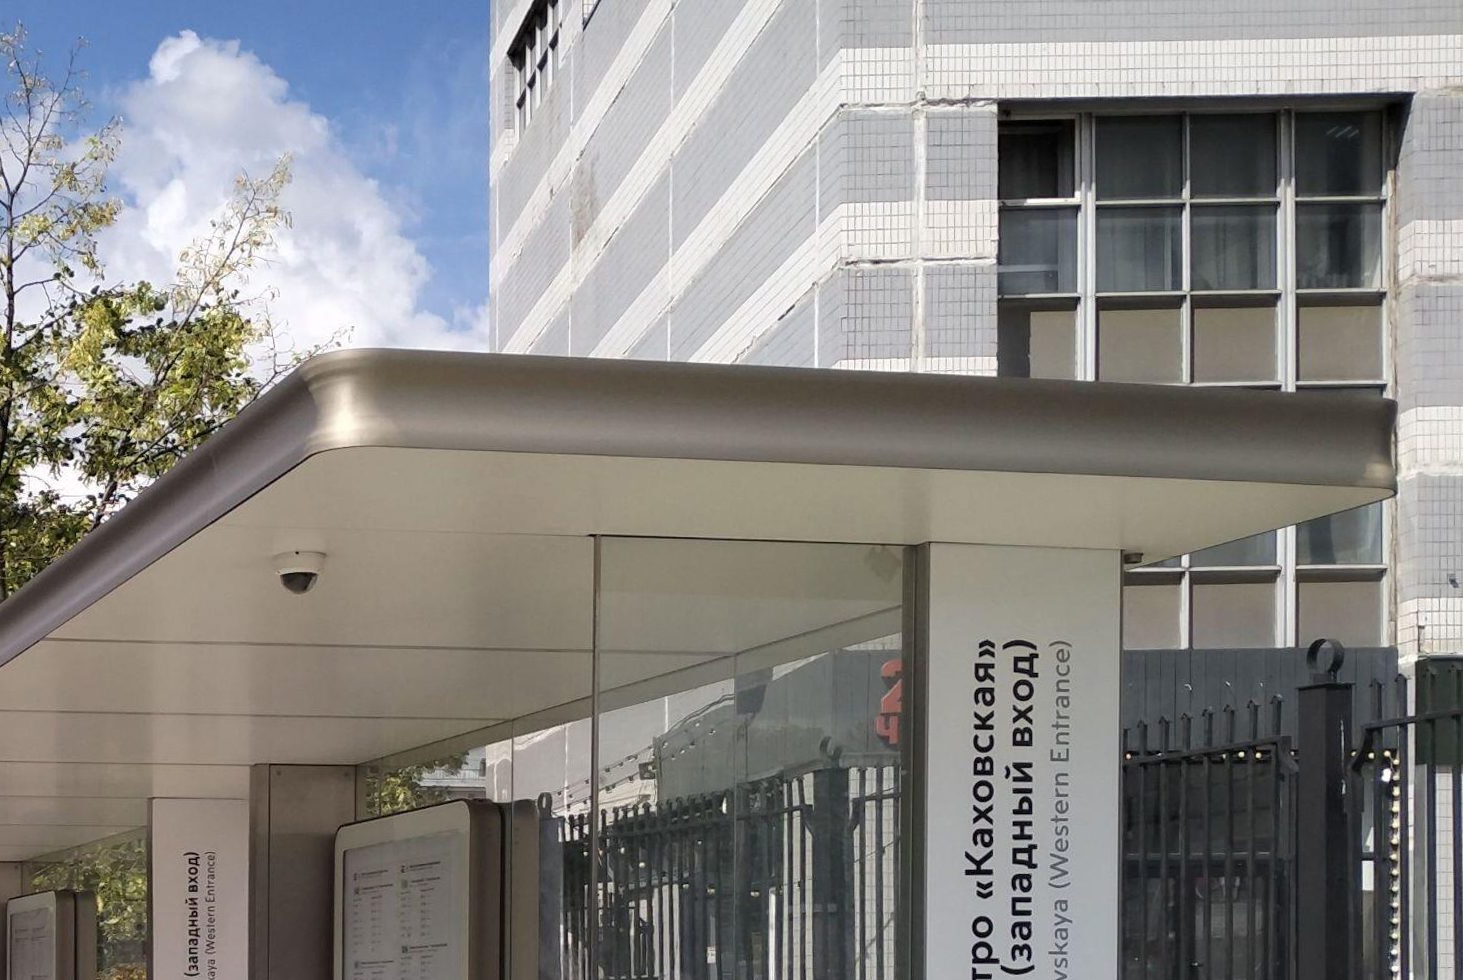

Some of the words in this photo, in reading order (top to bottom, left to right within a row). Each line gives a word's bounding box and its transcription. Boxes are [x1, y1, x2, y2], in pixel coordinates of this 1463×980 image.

[1001, 638, 1040, 748] вход)
[1047, 639, 1073, 763] Entrance)
[963, 638, 997, 900] «Каховская»
[183, 851, 201, 893] вход)
[204, 851, 217, 903] Entrance)
[1000, 761, 1040, 977] (западный
[1047, 771, 1073, 889] (Western
[184, 898, 201, 978] (западный
[205, 905, 217, 955] (Western
